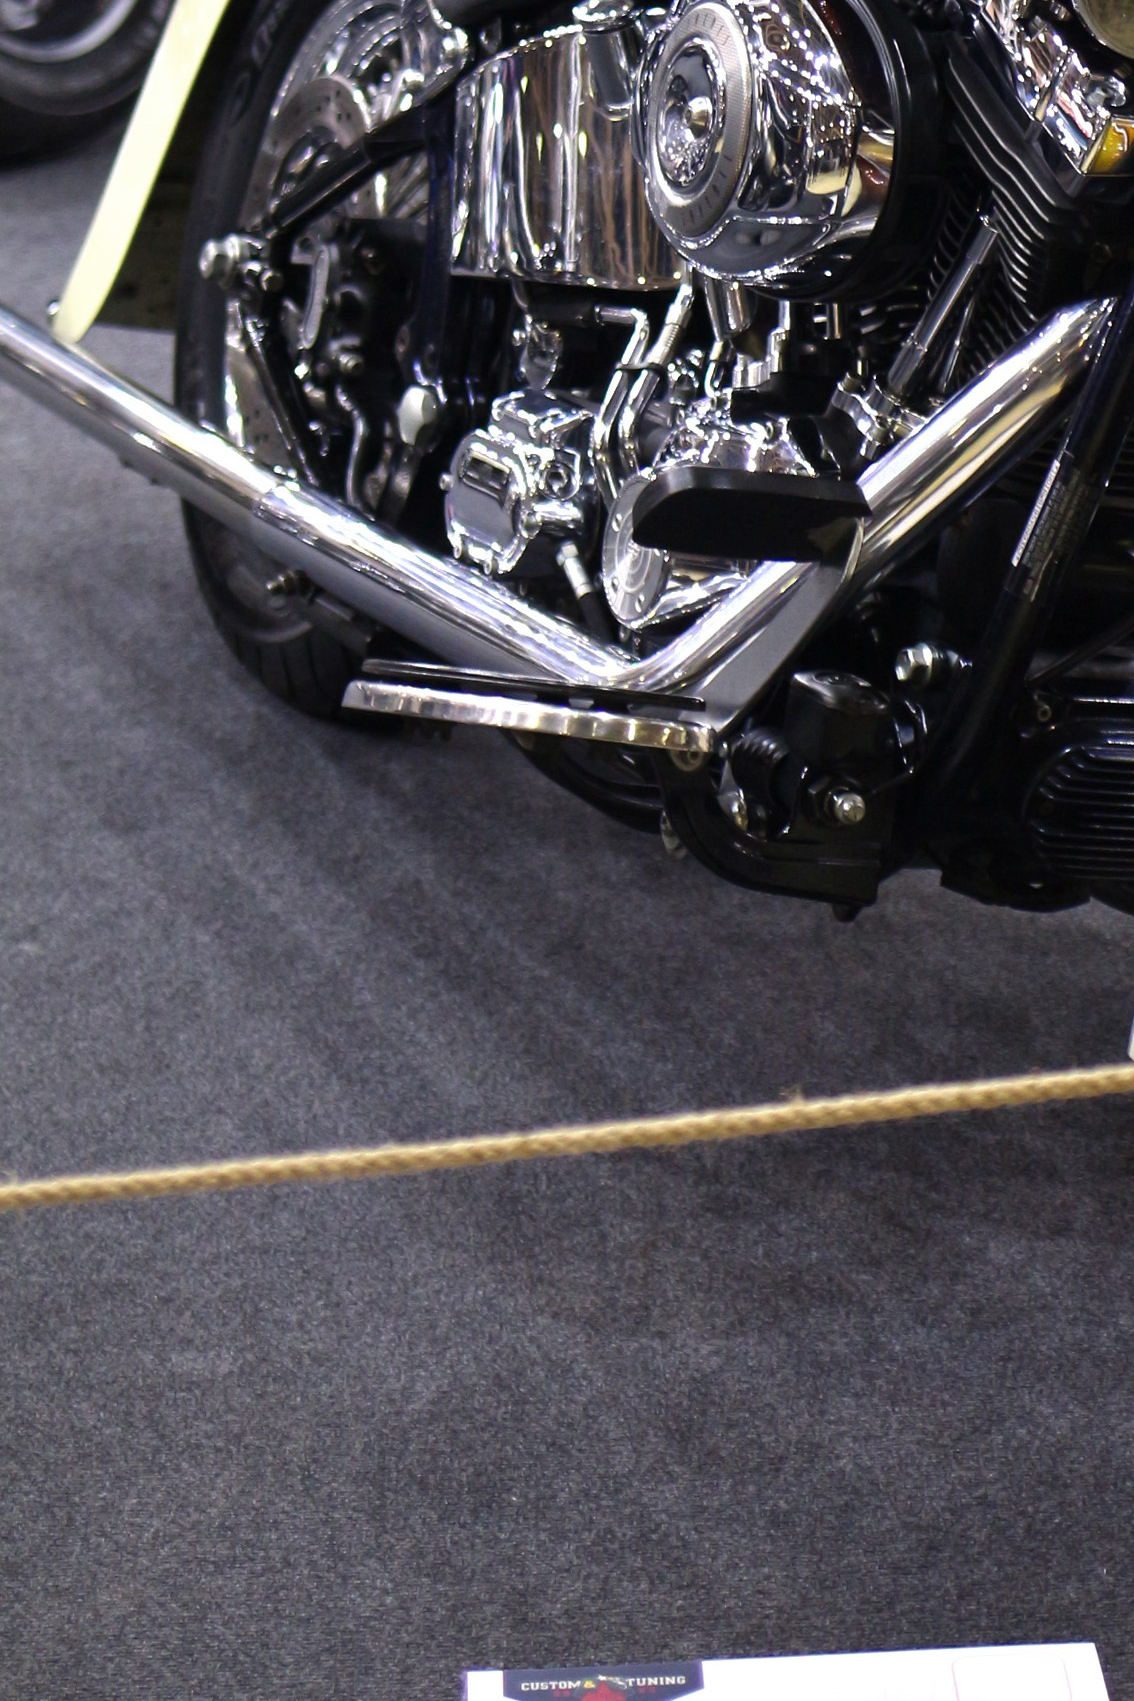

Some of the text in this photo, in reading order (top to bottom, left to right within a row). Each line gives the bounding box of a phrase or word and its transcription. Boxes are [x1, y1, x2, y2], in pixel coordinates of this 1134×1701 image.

[520, 1675, 686, 1692] CUSTOM & TUNING
